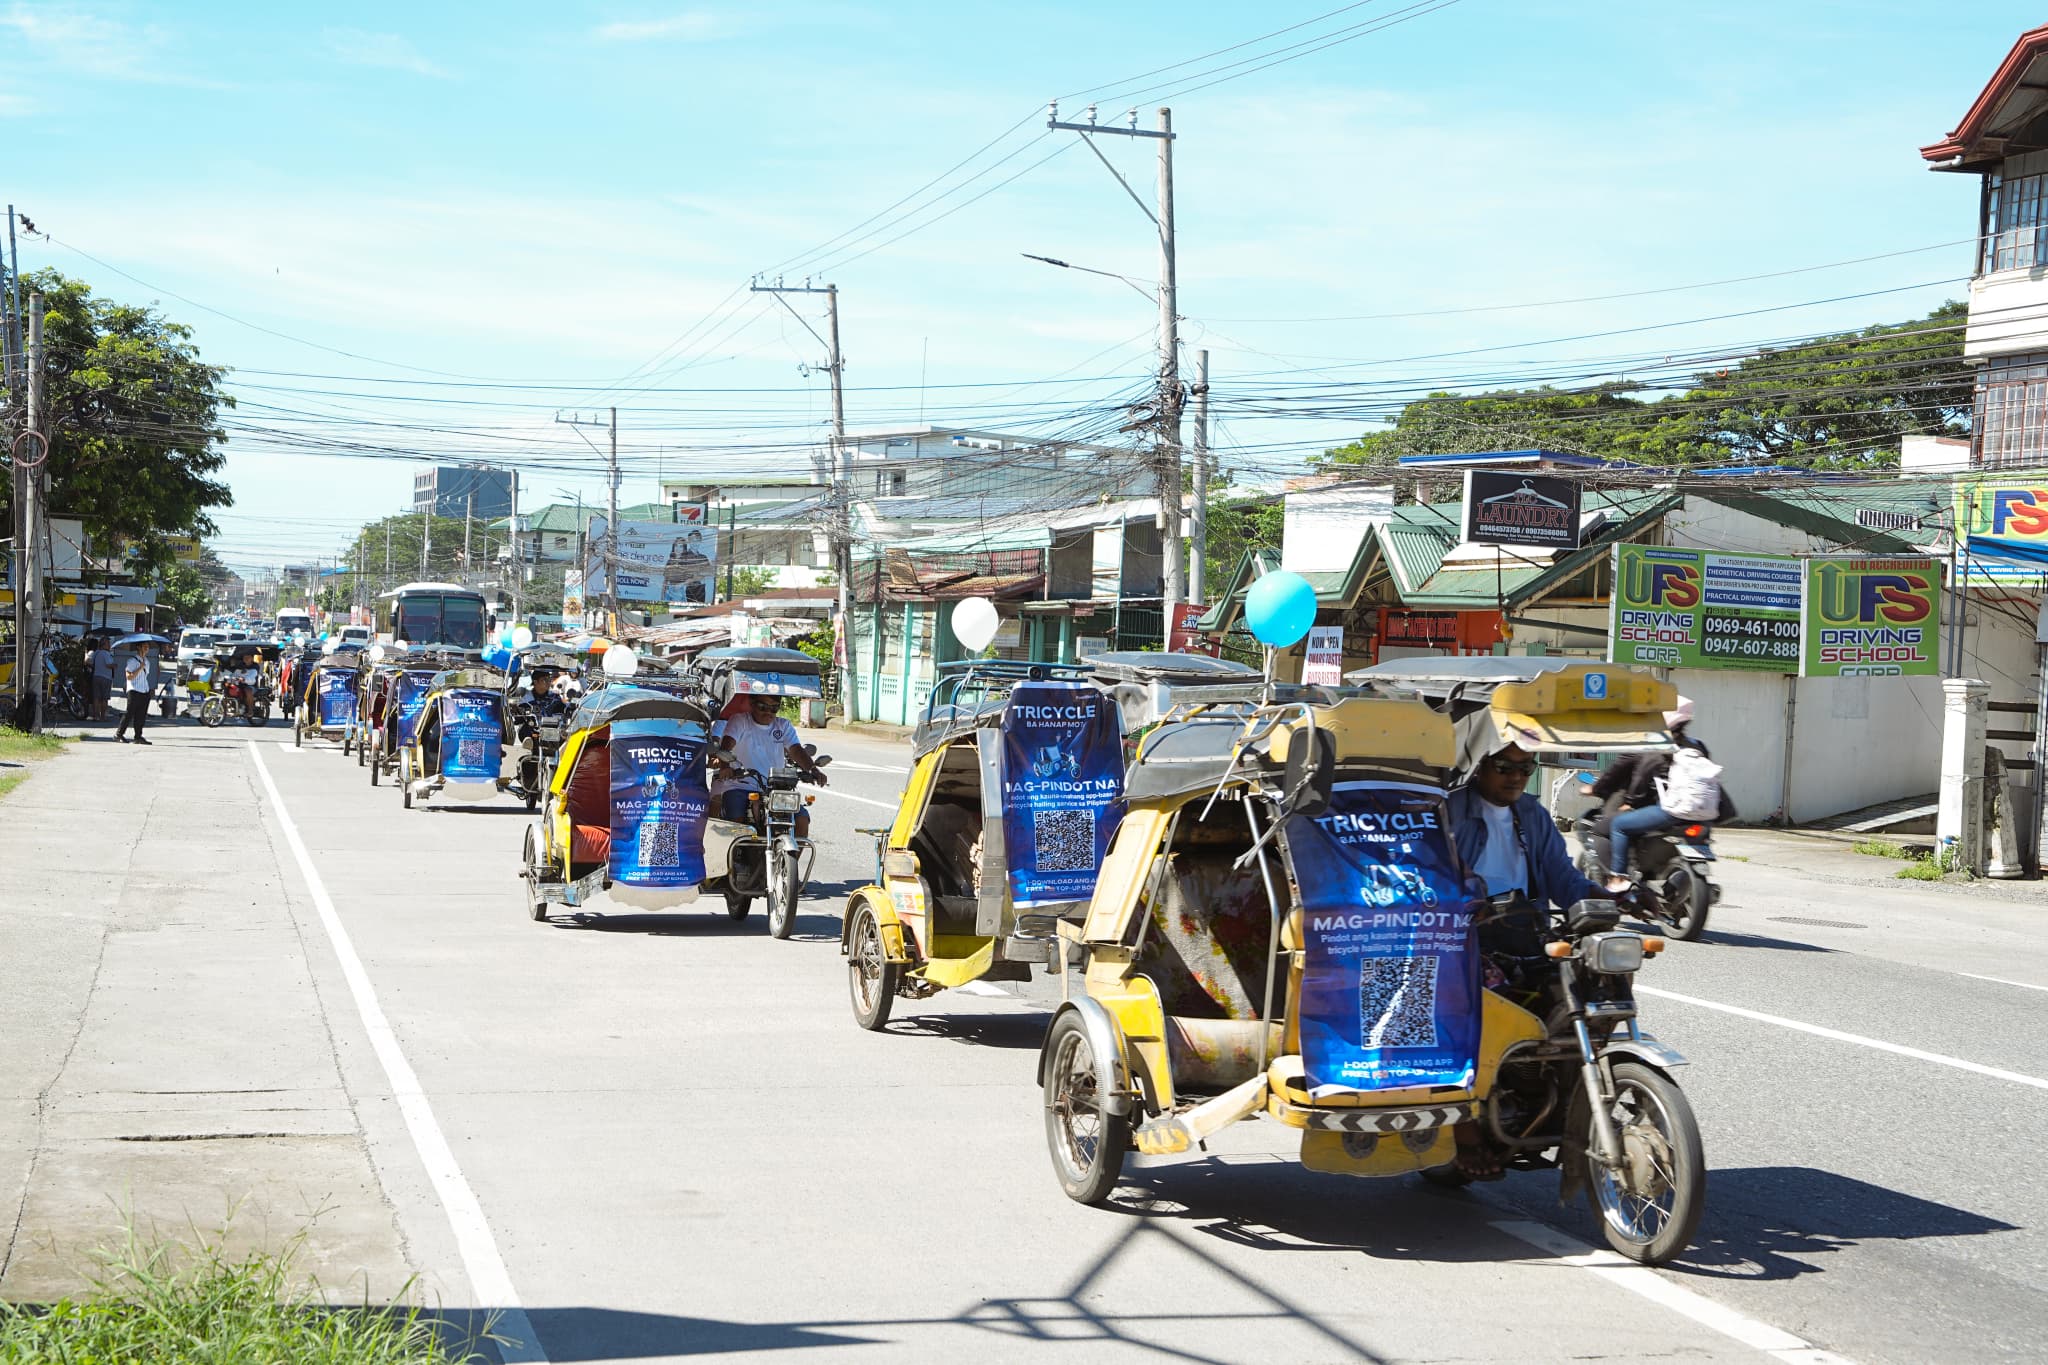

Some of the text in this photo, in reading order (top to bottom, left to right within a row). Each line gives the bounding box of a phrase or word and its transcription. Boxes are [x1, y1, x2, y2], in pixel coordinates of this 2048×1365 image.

[1476, 502, 1573, 528] LAUNDRY
[1707, 568, 1745, 577] THEORETICAL
[1746, 571, 1770, 579] DRIVING
[1771, 573, 1793, 581] COURSE
[1706, 592, 1740, 601] PRACTICAL
[1740, 595, 1766, 603] DRIVING
[1767, 596, 1790, 604] COURSE
[1621, 609, 1694, 630] DRIVING
[1705, 617, 1800, 638] 0969-461-000
[1620, 627, 1696, 645] SCHOOL
[1820, 626, 1923, 647] DRIVING
[1635, 645, 1682, 664] CORP.
[1704, 637, 1800, 657] 0947-607-888
[1819, 646, 1929, 664] SCHOOL
[1012, 704, 1096, 720] TRICYCLE
[1026, 720, 1037, 728] BA
[628, 747, 693, 760] TRICYCLE
[1005, 779, 1120, 793] MAG-PINDOT NA!
[616, 800, 705, 812] MAG-PINDOT NA!
[1034, 801, 1056, 809] hailing
[1314, 811, 1438, 833] TRICYCLE
[1340, 831, 1424, 844] BA HANAP MO?
[1313, 911, 1450, 932] MAG-PINDOT
[1321, 933, 1350, 943] Pindot
[1352, 934, 1369, 943] ang
[1328, 944, 1360, 955] tricycle
[1361, 943, 1392, 953] hailing
[1413, 1059, 1433, 1067] ANG
[1435, 1058, 1454, 1066] APP
